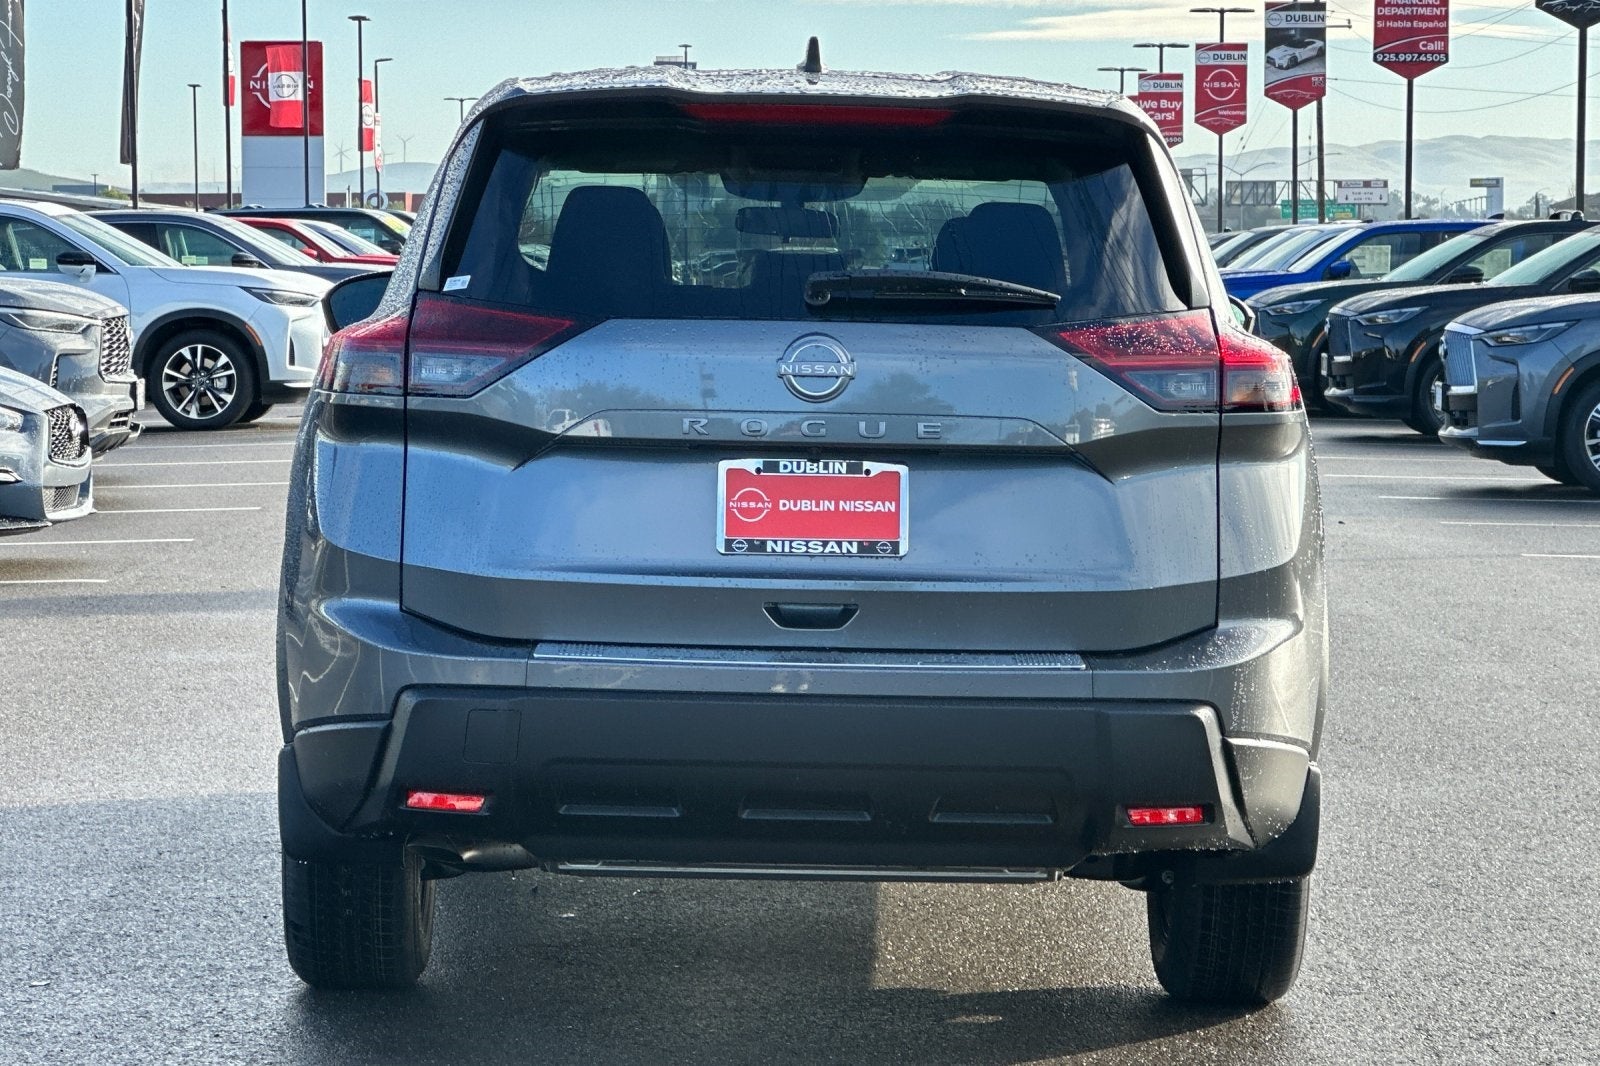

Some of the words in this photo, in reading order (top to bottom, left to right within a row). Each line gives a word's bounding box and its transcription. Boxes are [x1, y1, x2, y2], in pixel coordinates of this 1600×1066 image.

[1377, 7, 1447, 15] DEPARTMENT
[1285, 14, 1325, 22] DUBLIN
[1377, 20, 1385, 28] Si
[1386, 20, 1412, 28] Habla
[1413, 20, 1447, 29] Español
[1419, 41, 1445, 51] Call!
[1212, 53, 1247, 61] DUBLIN
[1376, 53, 1446, 62] 925.997.4505
[250, 80, 314, 89] NIN
[1140, 99, 1158, 109] We
[1160, 99, 1182, 111] Buy
[781, 363, 853, 375] NISSAN
[682, 417, 942, 440] ROGUE
[779, 461, 847, 474] DUBLIN
[729, 501, 772, 509] NISSAN
[779, 500, 835, 512] DUBLIN
[839, 501, 896, 513] NISSAN
[766, 541, 858, 554] NISSAN
